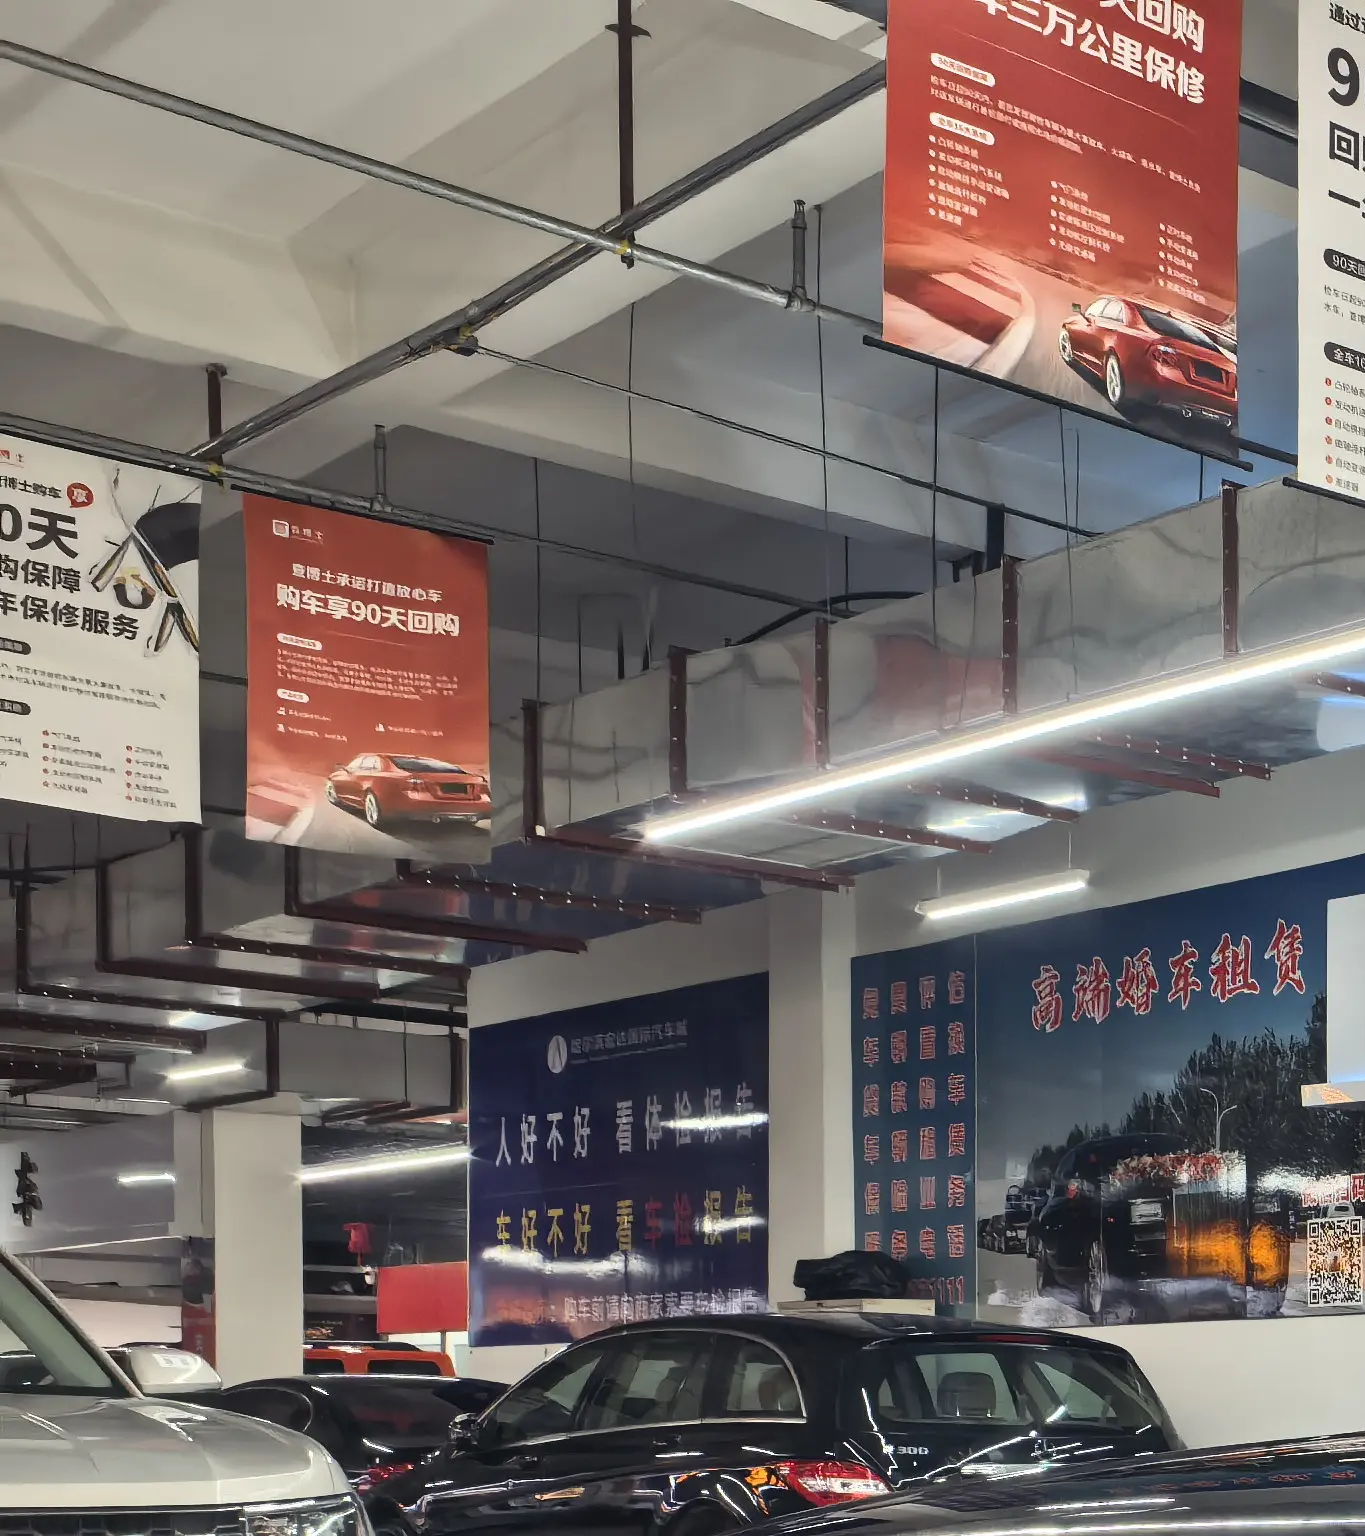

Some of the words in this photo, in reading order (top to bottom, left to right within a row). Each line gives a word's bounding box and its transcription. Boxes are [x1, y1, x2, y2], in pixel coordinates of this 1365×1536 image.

[276, 583, 460, 637] 购车享90天回购
[292, 563, 443, 603] 查博士承诺打造放心车
[1031, 918, 1306, 1033] 高端婚车租赁
[496, 1106, 592, 1167] 人好不好
[495, 1201, 593, 1258] 车好不好
